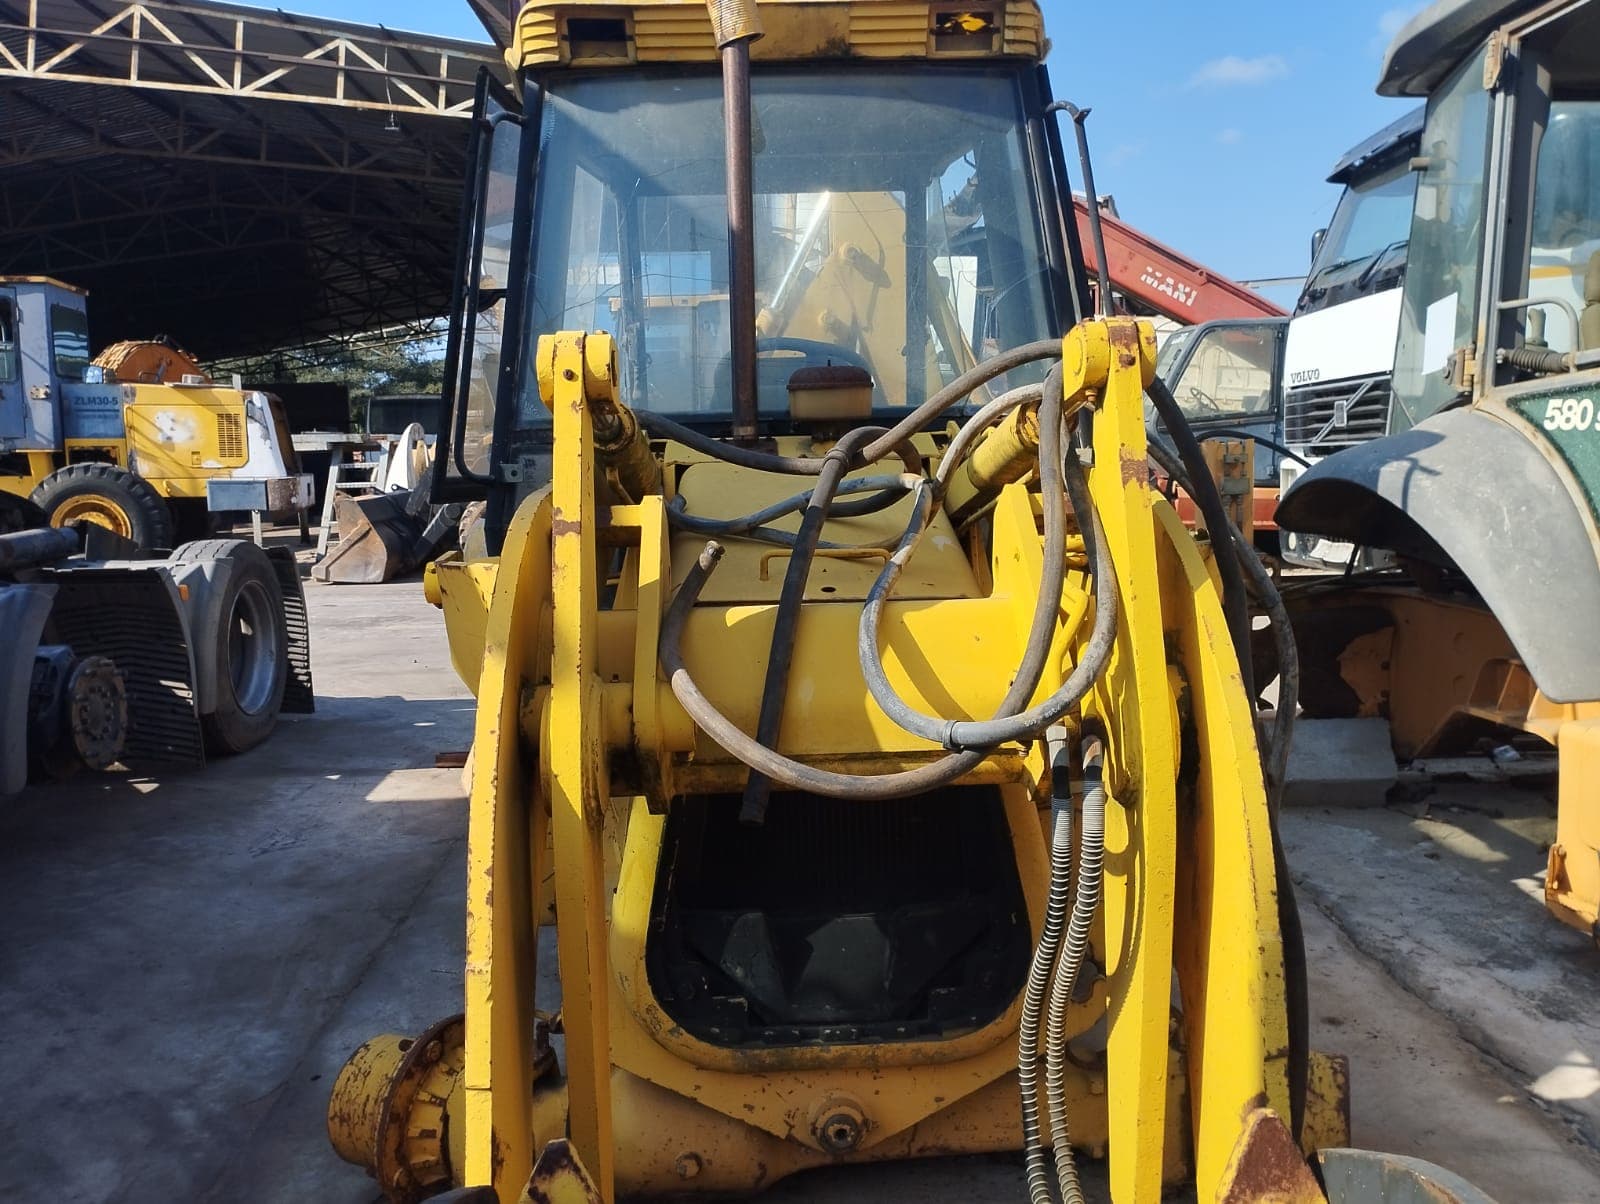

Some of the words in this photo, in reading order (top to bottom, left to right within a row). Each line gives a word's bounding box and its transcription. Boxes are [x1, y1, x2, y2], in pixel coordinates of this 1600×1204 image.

[1290, 368, 1321, 384] VOLVO
[74, 396, 119, 406] ZLM30-5
[1543, 398, 1594, 431] 580
